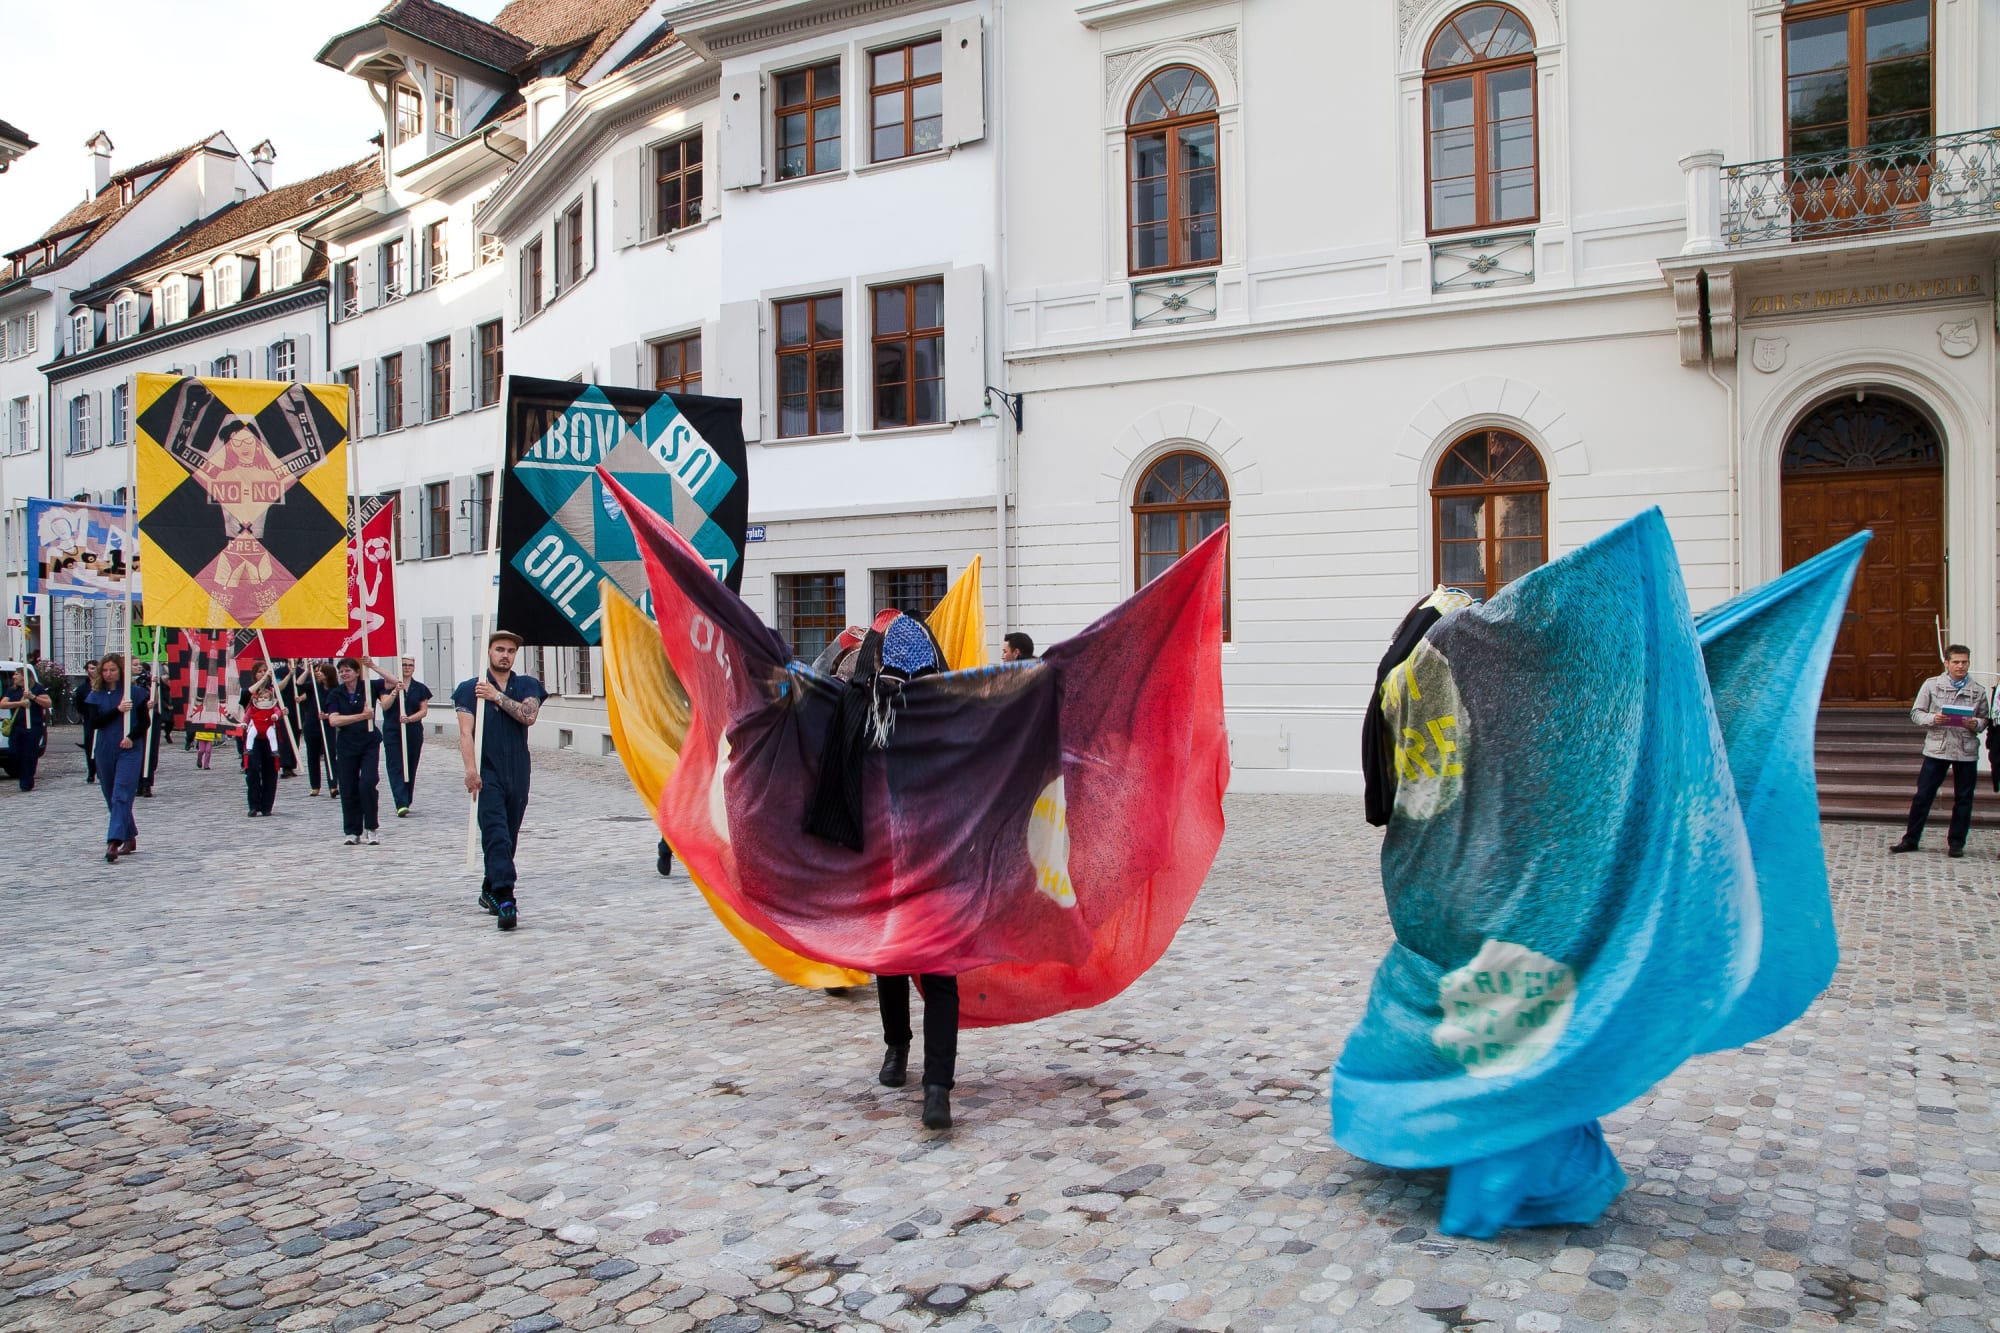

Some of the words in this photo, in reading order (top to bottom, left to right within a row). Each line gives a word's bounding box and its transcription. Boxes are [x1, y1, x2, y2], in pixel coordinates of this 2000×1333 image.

[1812, 282, 1889, 309] JOHANN
[1893, 273, 1980, 299] CAPELLE
[298, 412, 320, 460] SLUT
[181, 447, 217, 473] BODY
[275, 455, 312, 479] PROUD
[227, 540, 261, 552] FREE
